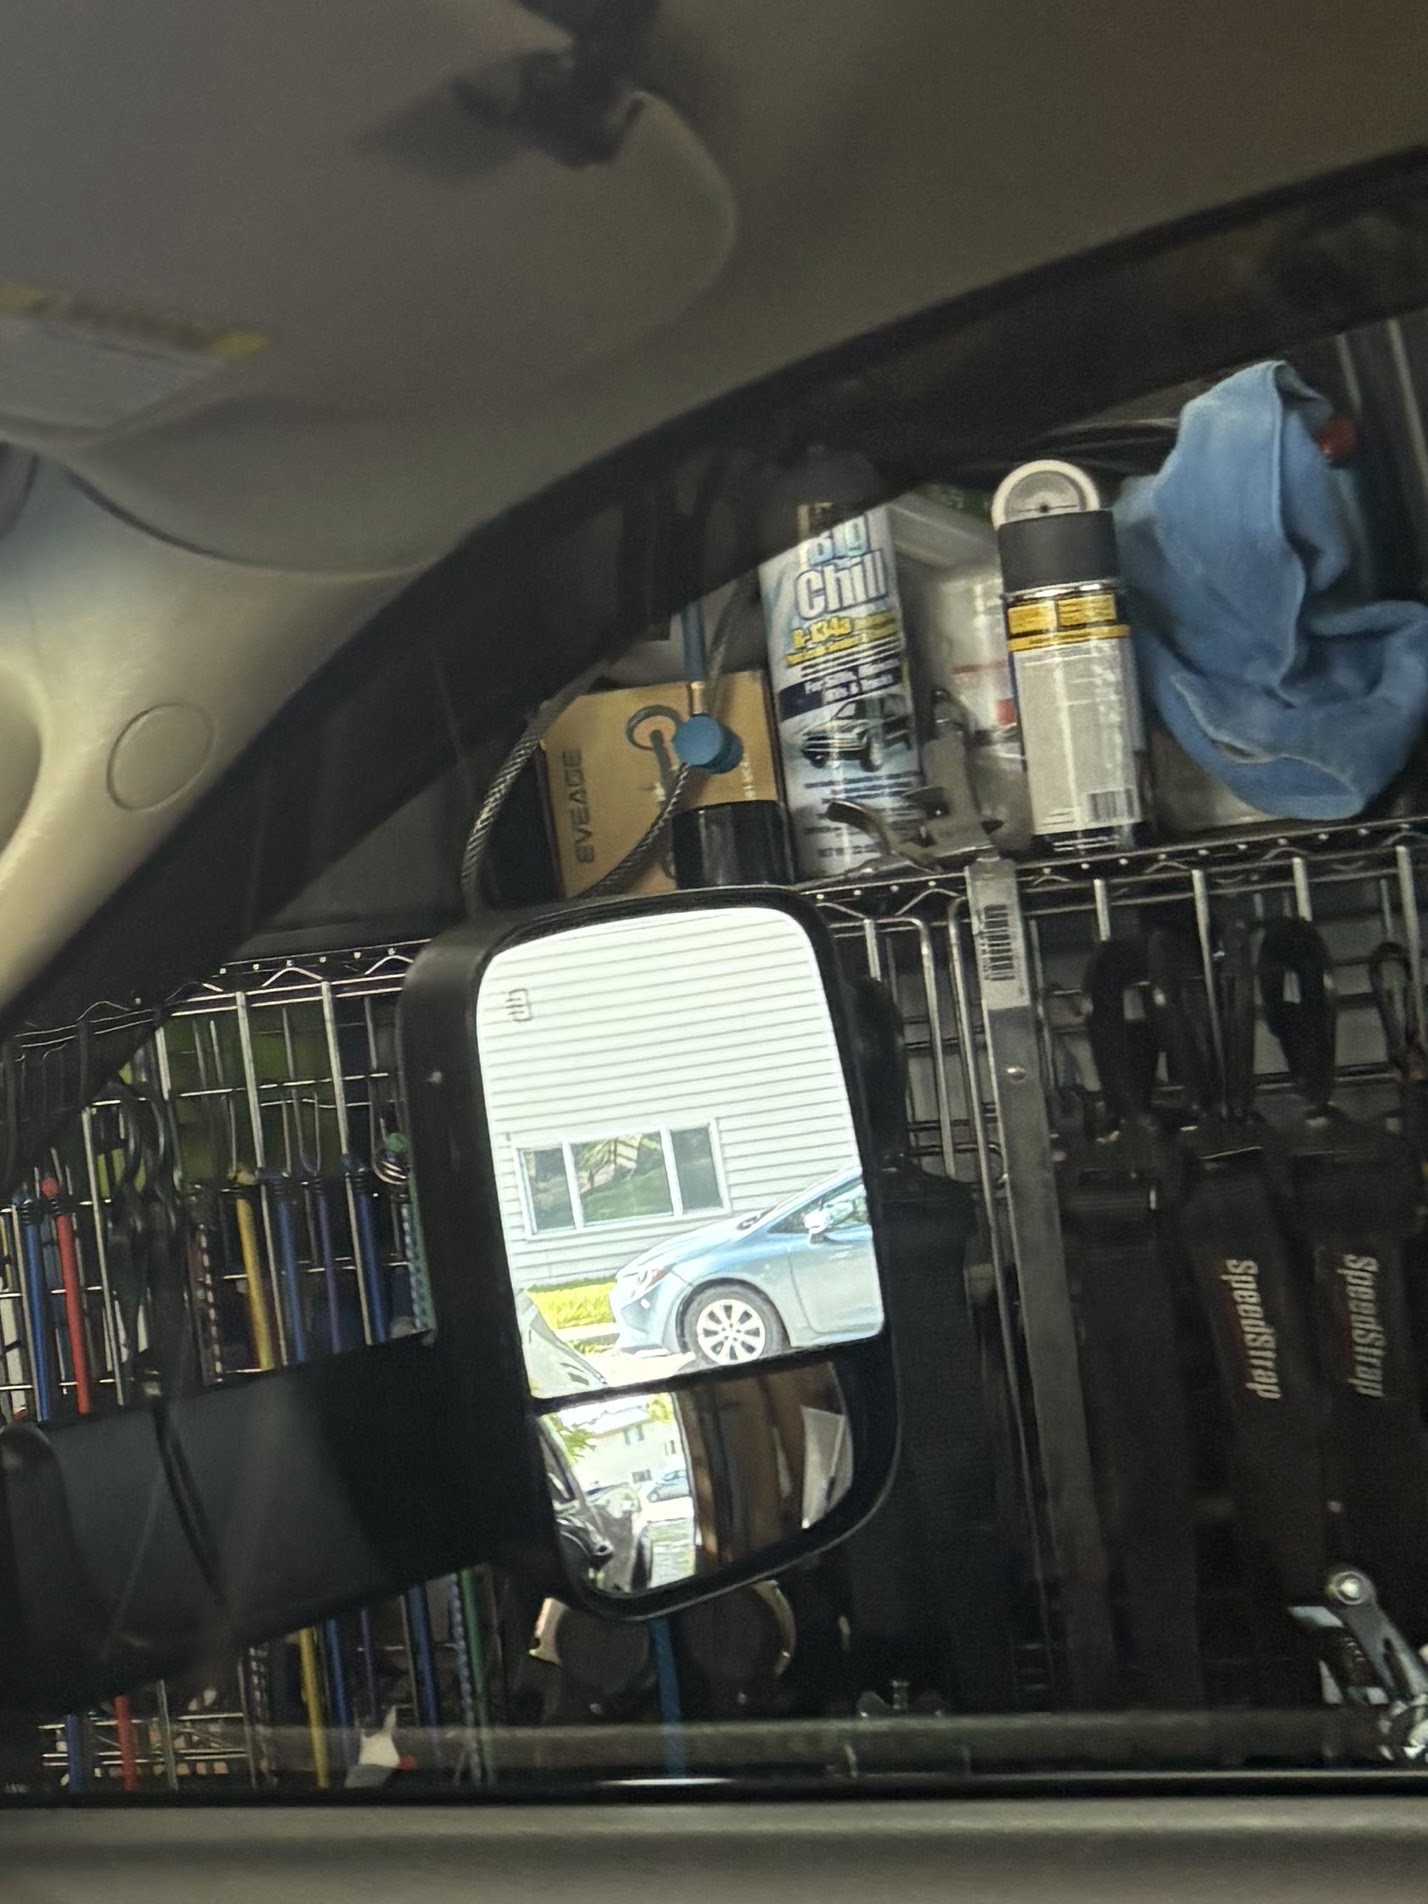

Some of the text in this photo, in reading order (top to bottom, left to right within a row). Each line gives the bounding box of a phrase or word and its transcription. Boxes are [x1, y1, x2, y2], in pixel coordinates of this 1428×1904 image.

[794, 548, 889, 621] Chill
[1220, 1259, 1282, 1399] SpeedStrap
[1336, 1254, 1386, 1397] SpeedStrap
